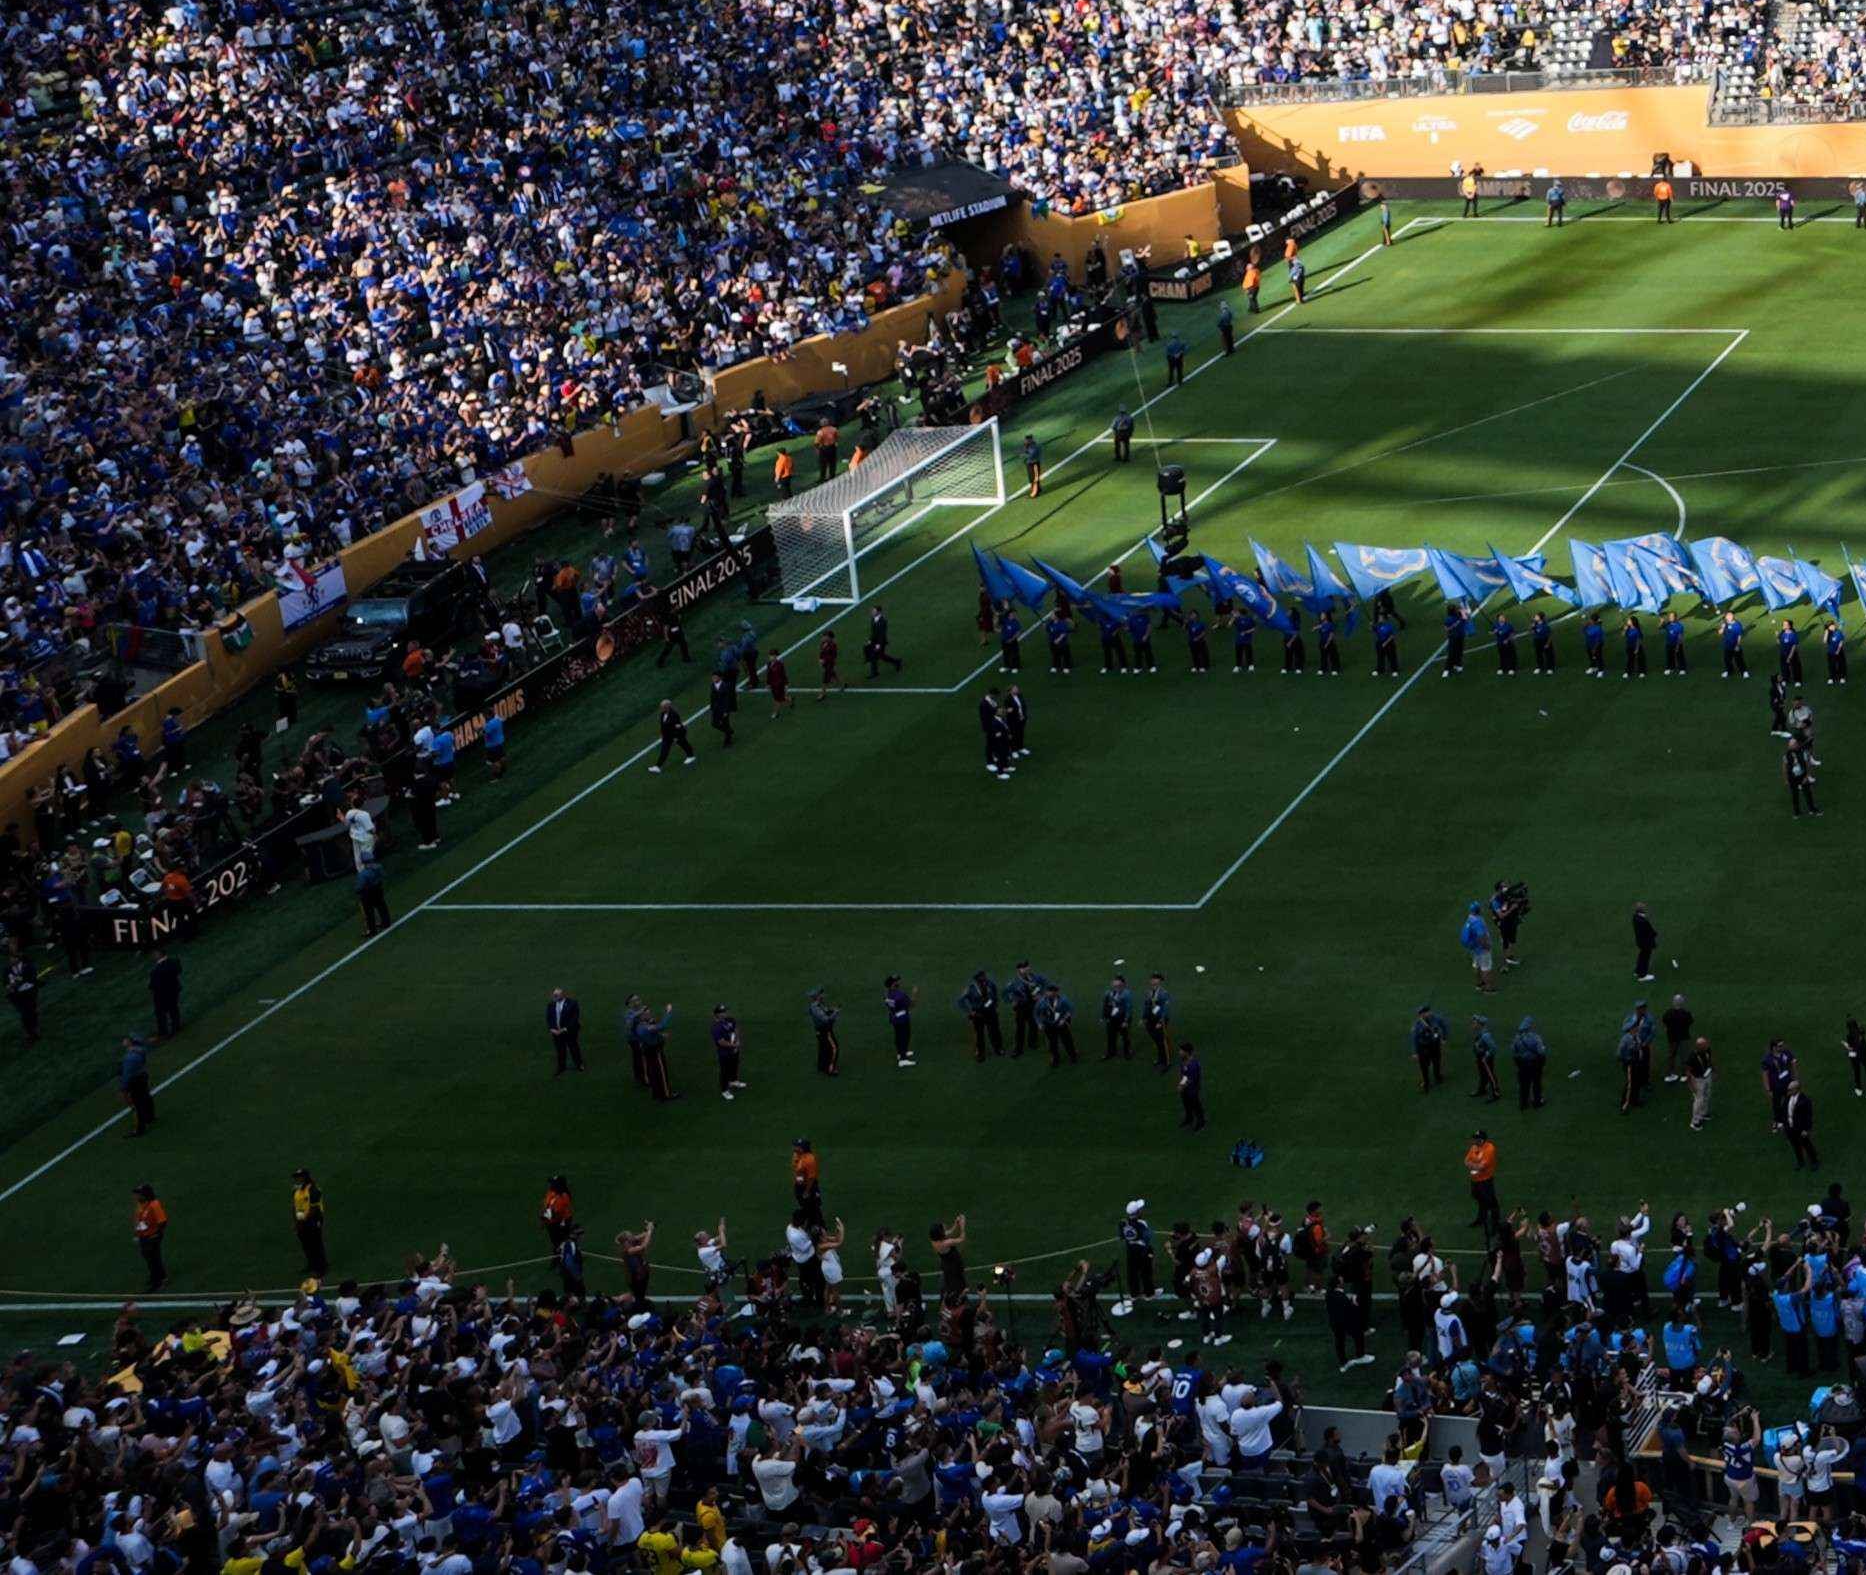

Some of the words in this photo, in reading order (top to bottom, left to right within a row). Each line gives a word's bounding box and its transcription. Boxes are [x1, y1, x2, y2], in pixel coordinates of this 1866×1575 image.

[1338, 125, 1387, 143] FIFA
[1690, 181, 1741, 197] FINAL
[1021, 363, 1056, 396] FINAL
[1054, 346, 1083, 375] 2025
[716, 543, 753, 583] 205
[205, 861, 250, 907] 202
